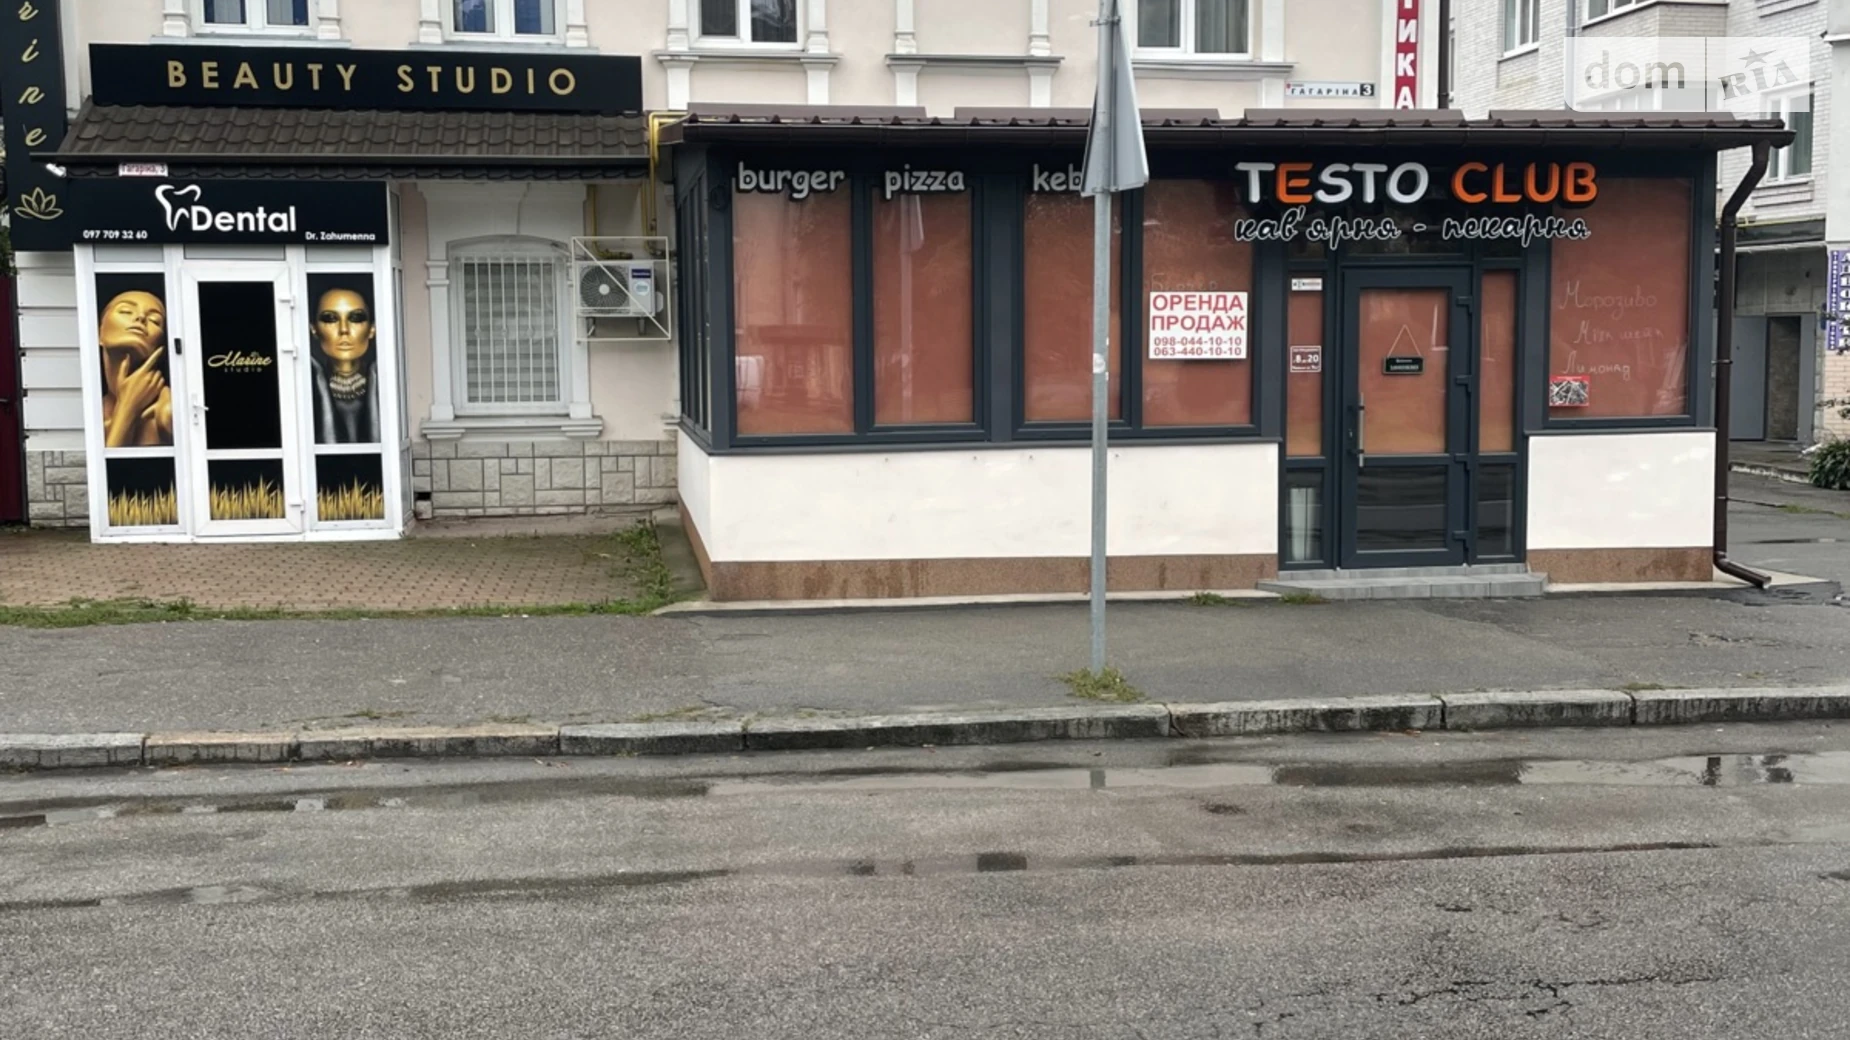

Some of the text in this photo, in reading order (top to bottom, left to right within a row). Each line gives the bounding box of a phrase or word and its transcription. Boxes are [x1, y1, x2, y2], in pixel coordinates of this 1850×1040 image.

[167, 60, 576, 95] BEAUTY STUDIO
[1291, 84, 1373, 96] ГАГАРІНА 3
[738, 161, 845, 199] burger
[884, 164, 964, 200] pizza
[1235, 162, 1598, 204] TESTO CLUB
[191, 205, 297, 232] Dental
[82, 230, 101, 239] 097
[103, 230, 119, 239] 709
[122, 230, 134, 239] 32
[305, 231, 375, 241] Dr. Zahumenna
[1442, 213, 1591, 248] пекарня
[1152, 294, 1244, 314] ОРЕНДА
[1151, 315, 1245, 334] ПРОДАЖ
[1153, 337, 1242, 347] 098-044-10-10
[1153, 347, 1242, 356] 063-440-10-10
